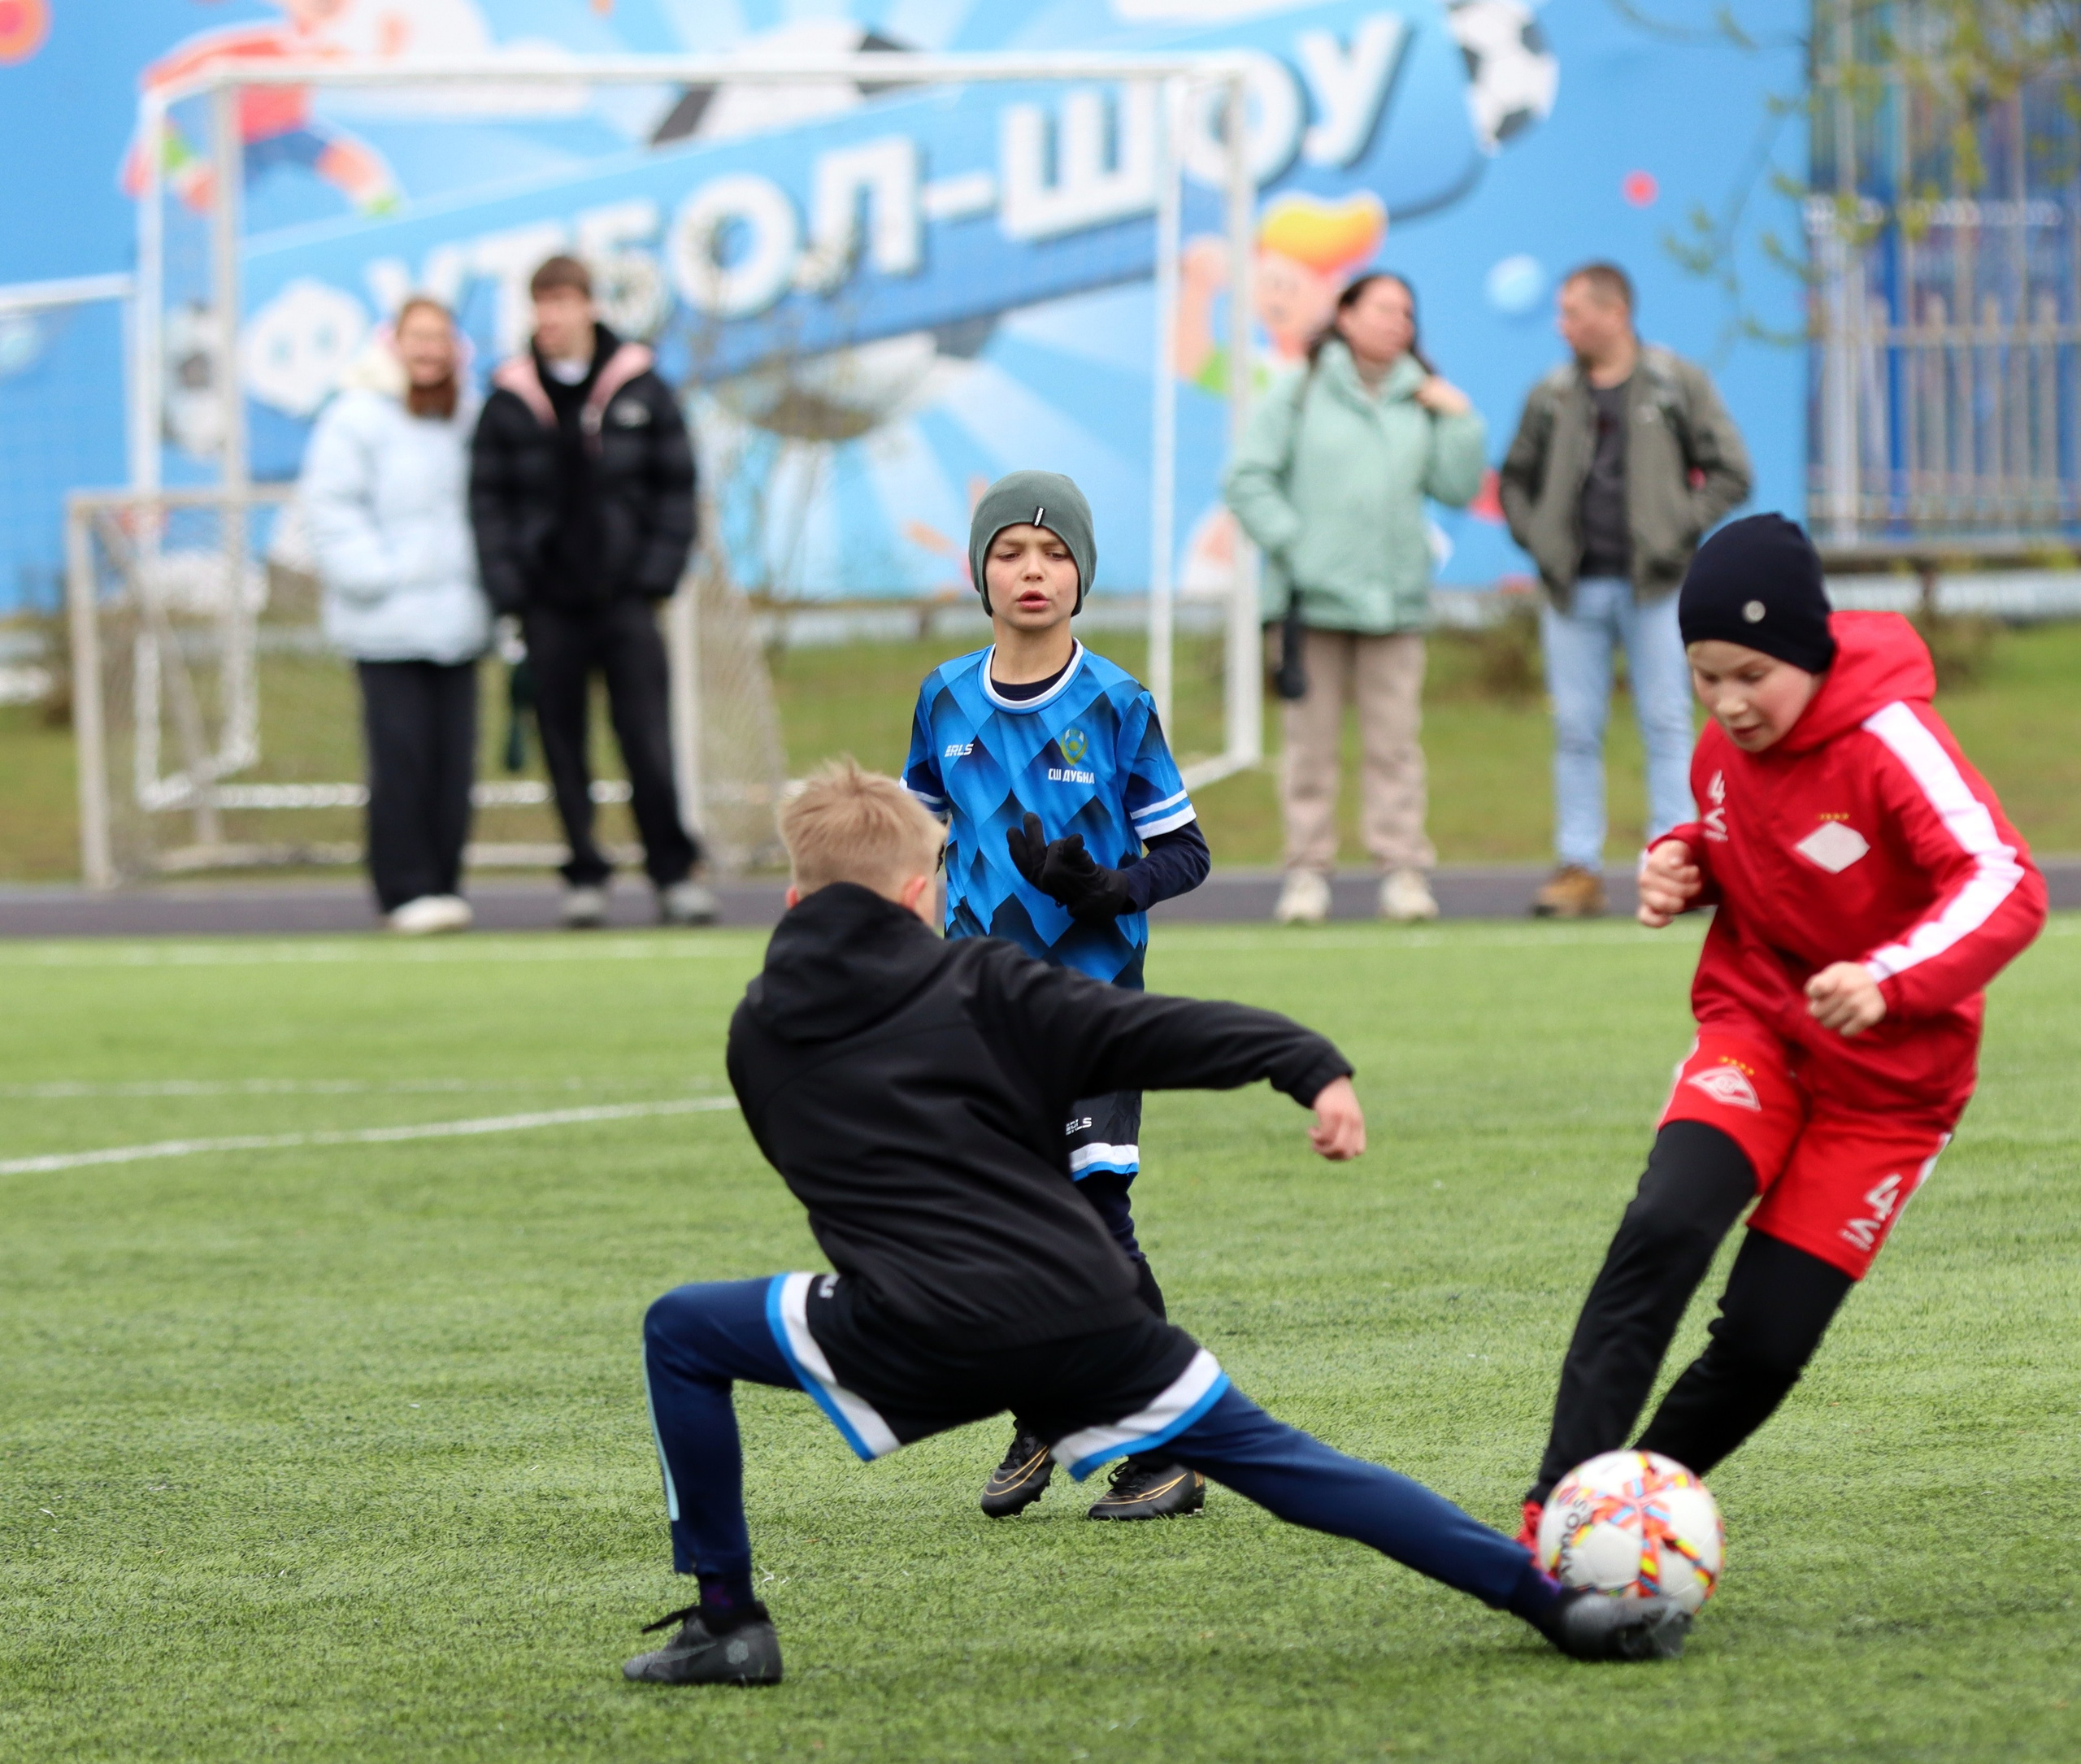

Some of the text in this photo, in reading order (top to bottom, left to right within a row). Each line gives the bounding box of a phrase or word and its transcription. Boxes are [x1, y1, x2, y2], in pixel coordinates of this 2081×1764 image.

[1048, 767, 1095, 784] СШ ДУБНА
[1707, 769, 1726, 806] 4
[1865, 1173, 1903, 1222] 4
